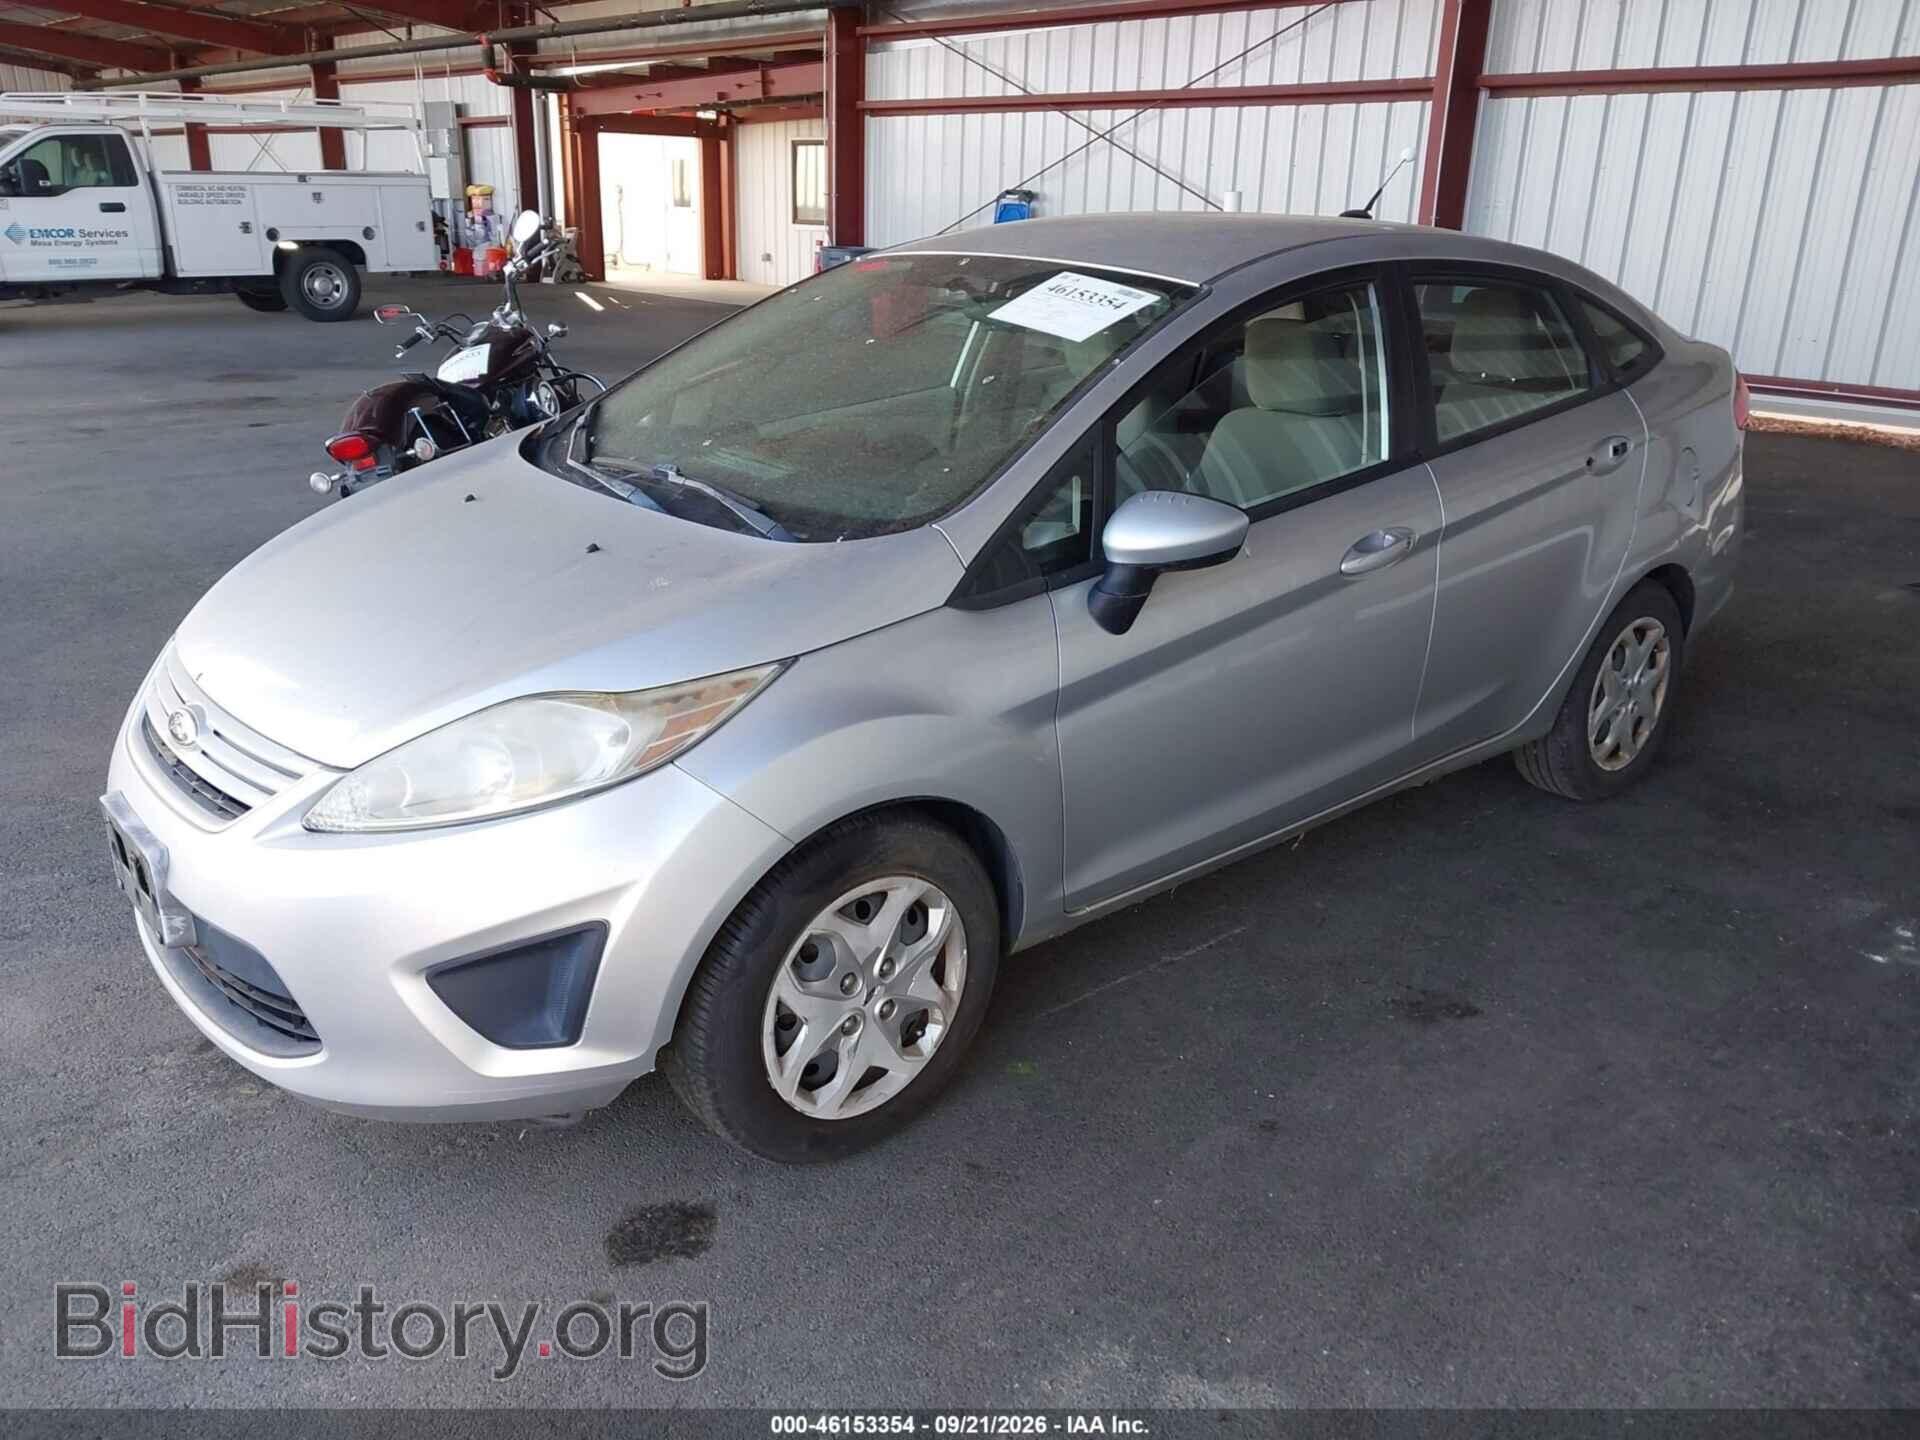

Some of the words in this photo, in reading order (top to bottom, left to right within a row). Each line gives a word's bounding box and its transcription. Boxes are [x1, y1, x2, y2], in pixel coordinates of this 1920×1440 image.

[29, 228, 75, 239] EMCOR
[78, 228, 129, 238] Services
[1047, 284, 1129, 309] 46153354
